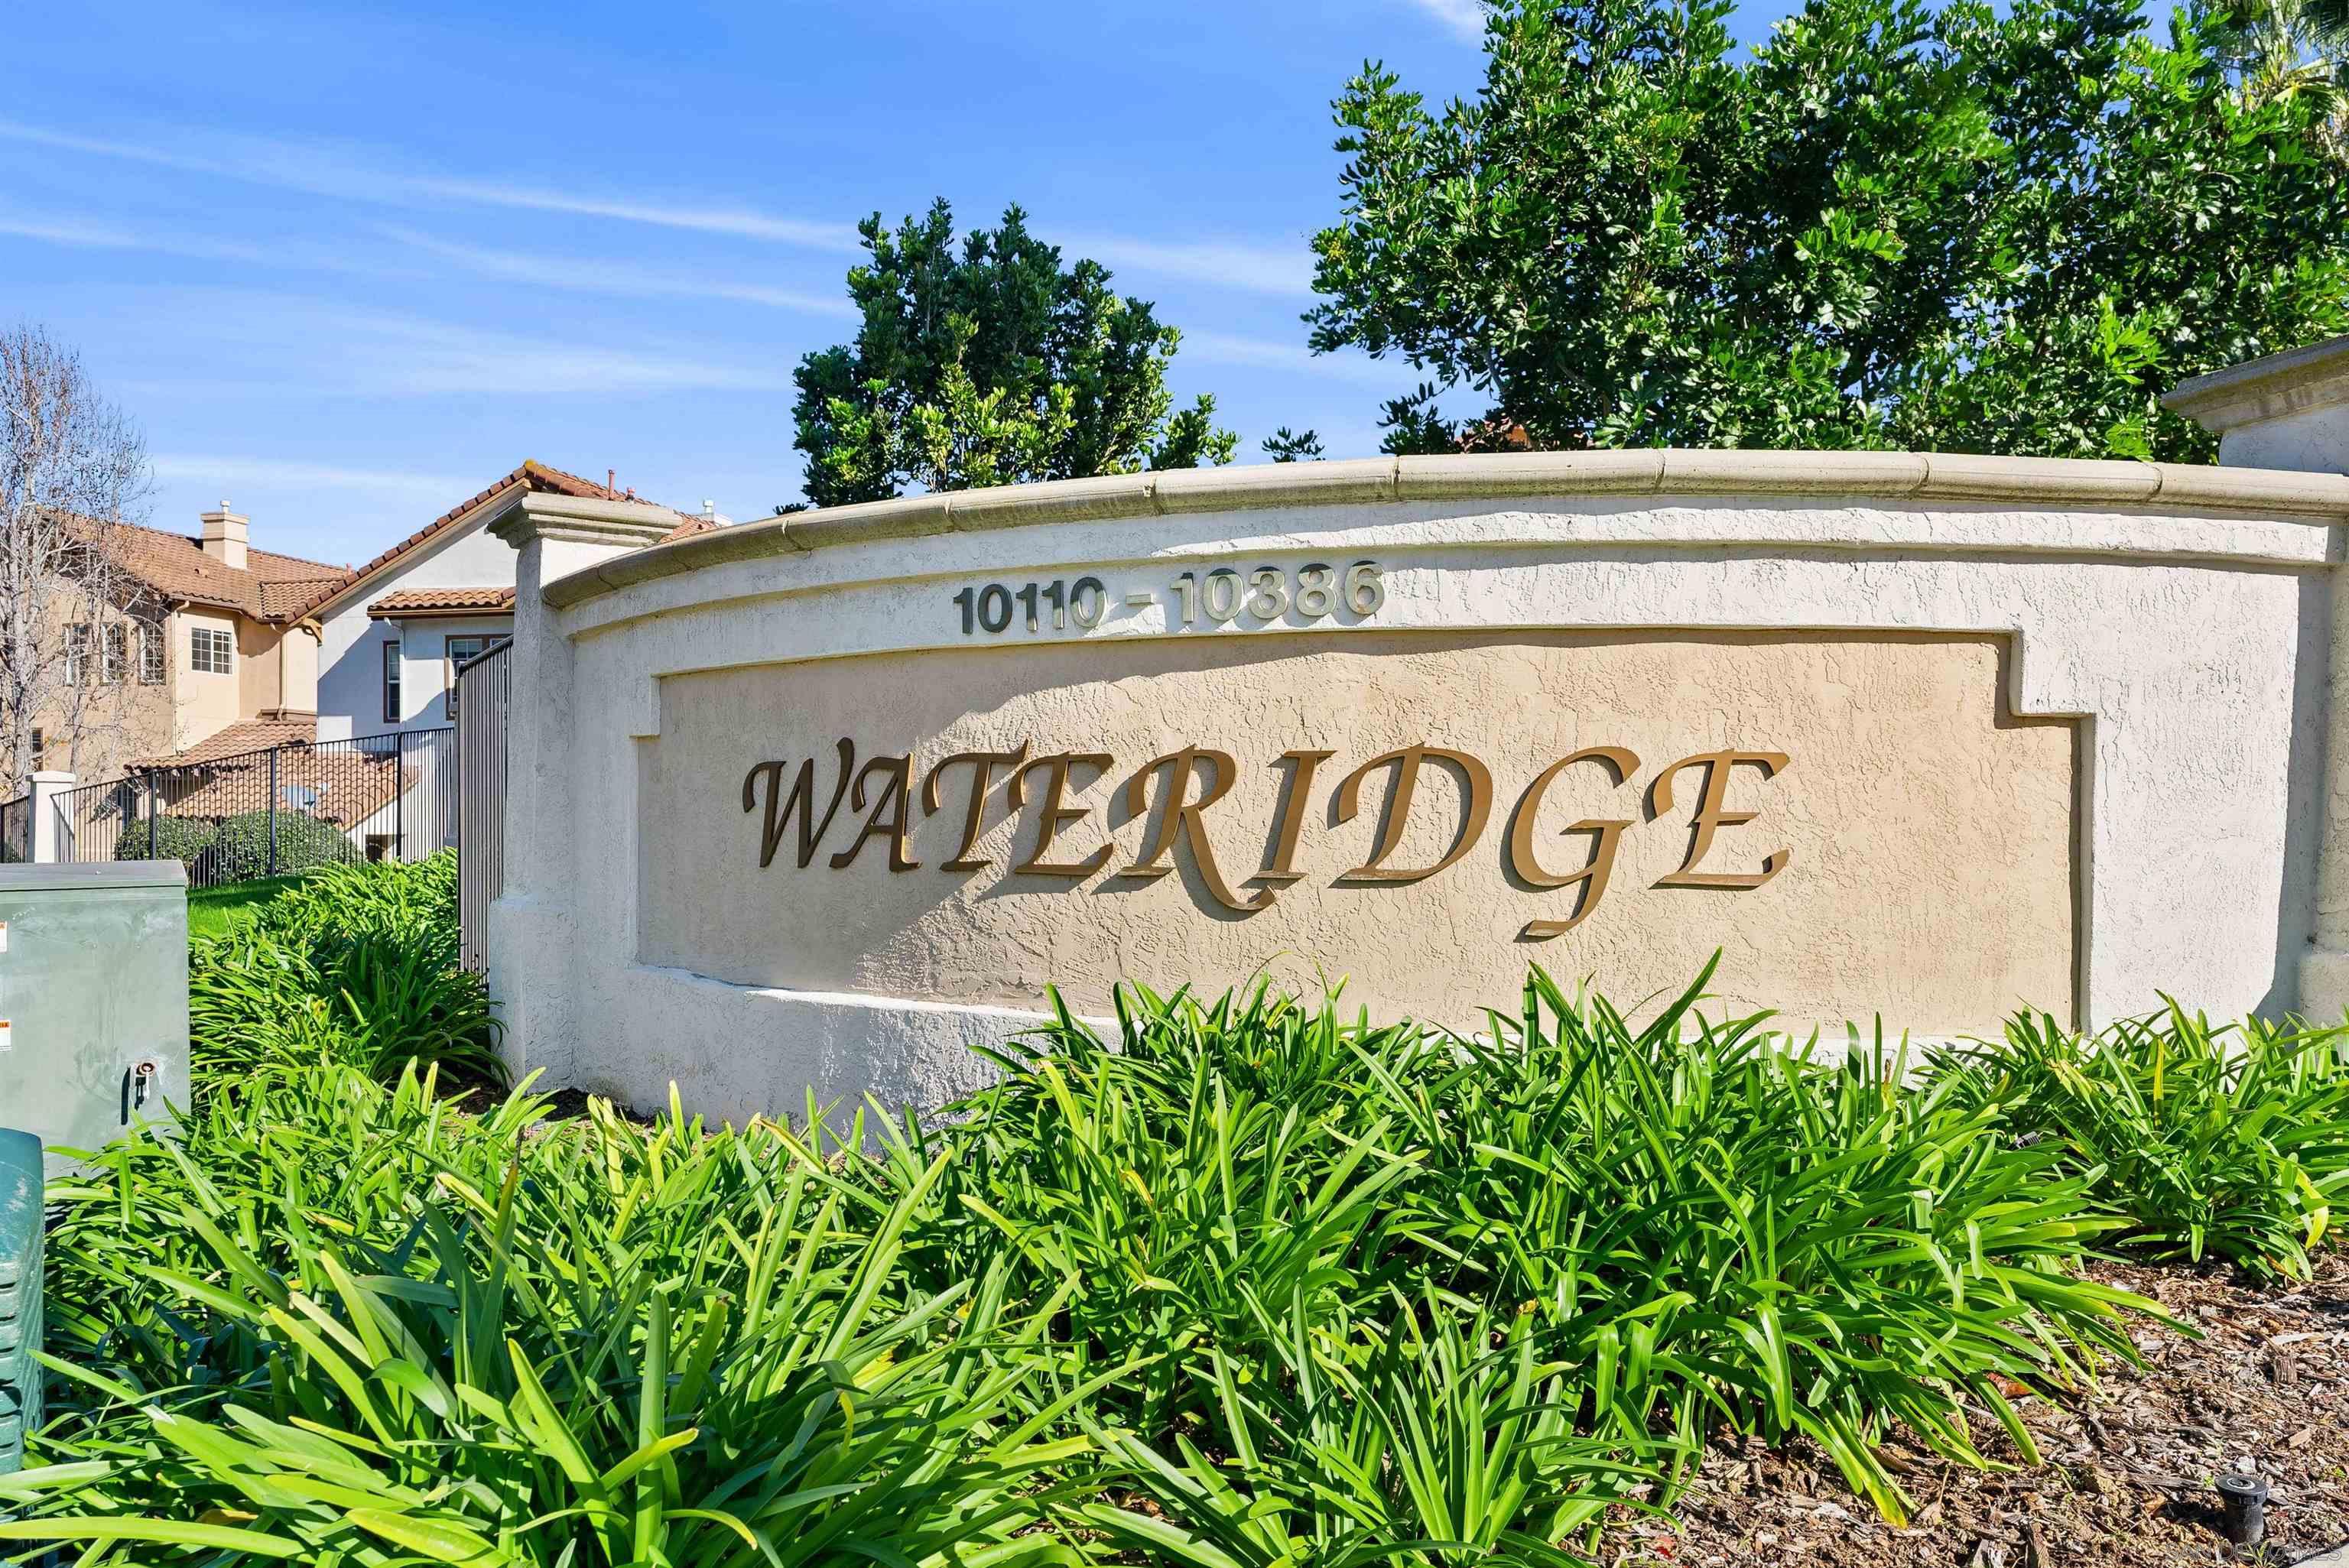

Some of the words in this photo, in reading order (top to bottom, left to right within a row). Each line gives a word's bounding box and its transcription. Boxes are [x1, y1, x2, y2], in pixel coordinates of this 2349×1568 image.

[953, 576, 1107, 635] 10110
[1170, 560, 1385, 623] 10386
[742, 737, 1791, 940] WATERIDGE
